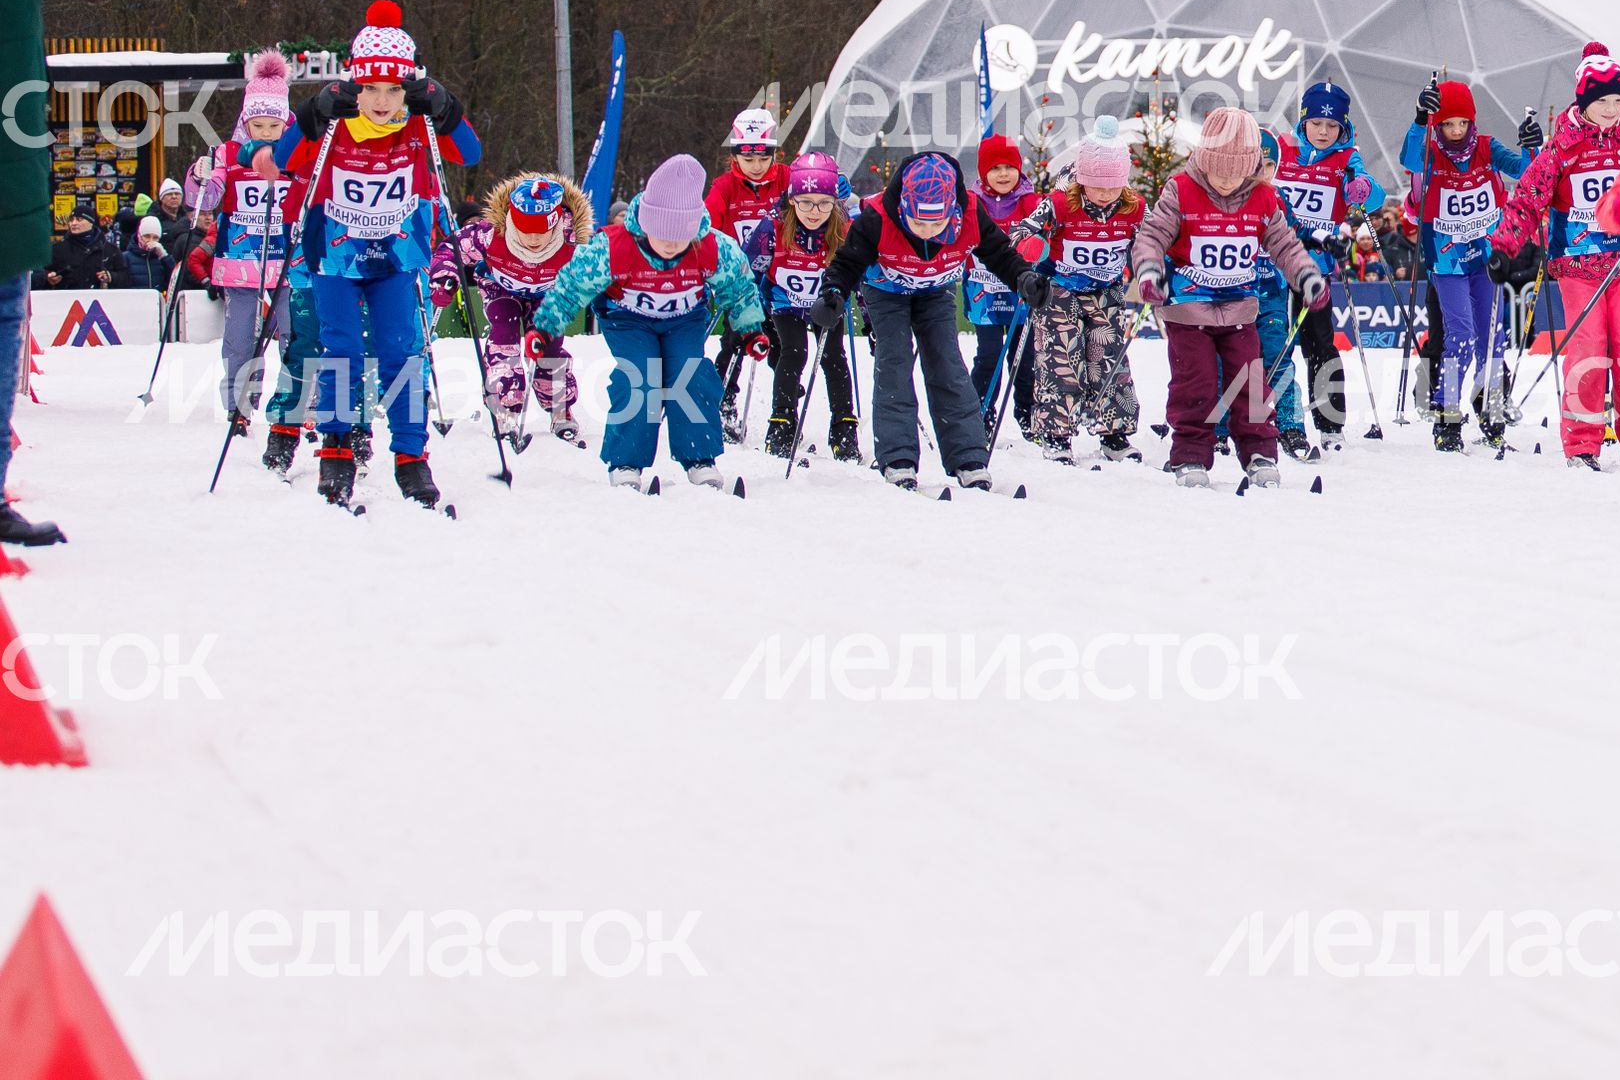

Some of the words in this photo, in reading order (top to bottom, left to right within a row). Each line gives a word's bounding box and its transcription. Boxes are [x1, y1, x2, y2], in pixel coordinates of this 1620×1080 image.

[343, 176, 406, 208] 674
[1447, 190, 1490, 217] 659
[327, 197, 417, 229] МАНЖОСОВСКАЯ
[1072, 246, 1122, 266] 665
[1200, 243, 1253, 271] 669
[1360, 331, 1396, 349] SKI
